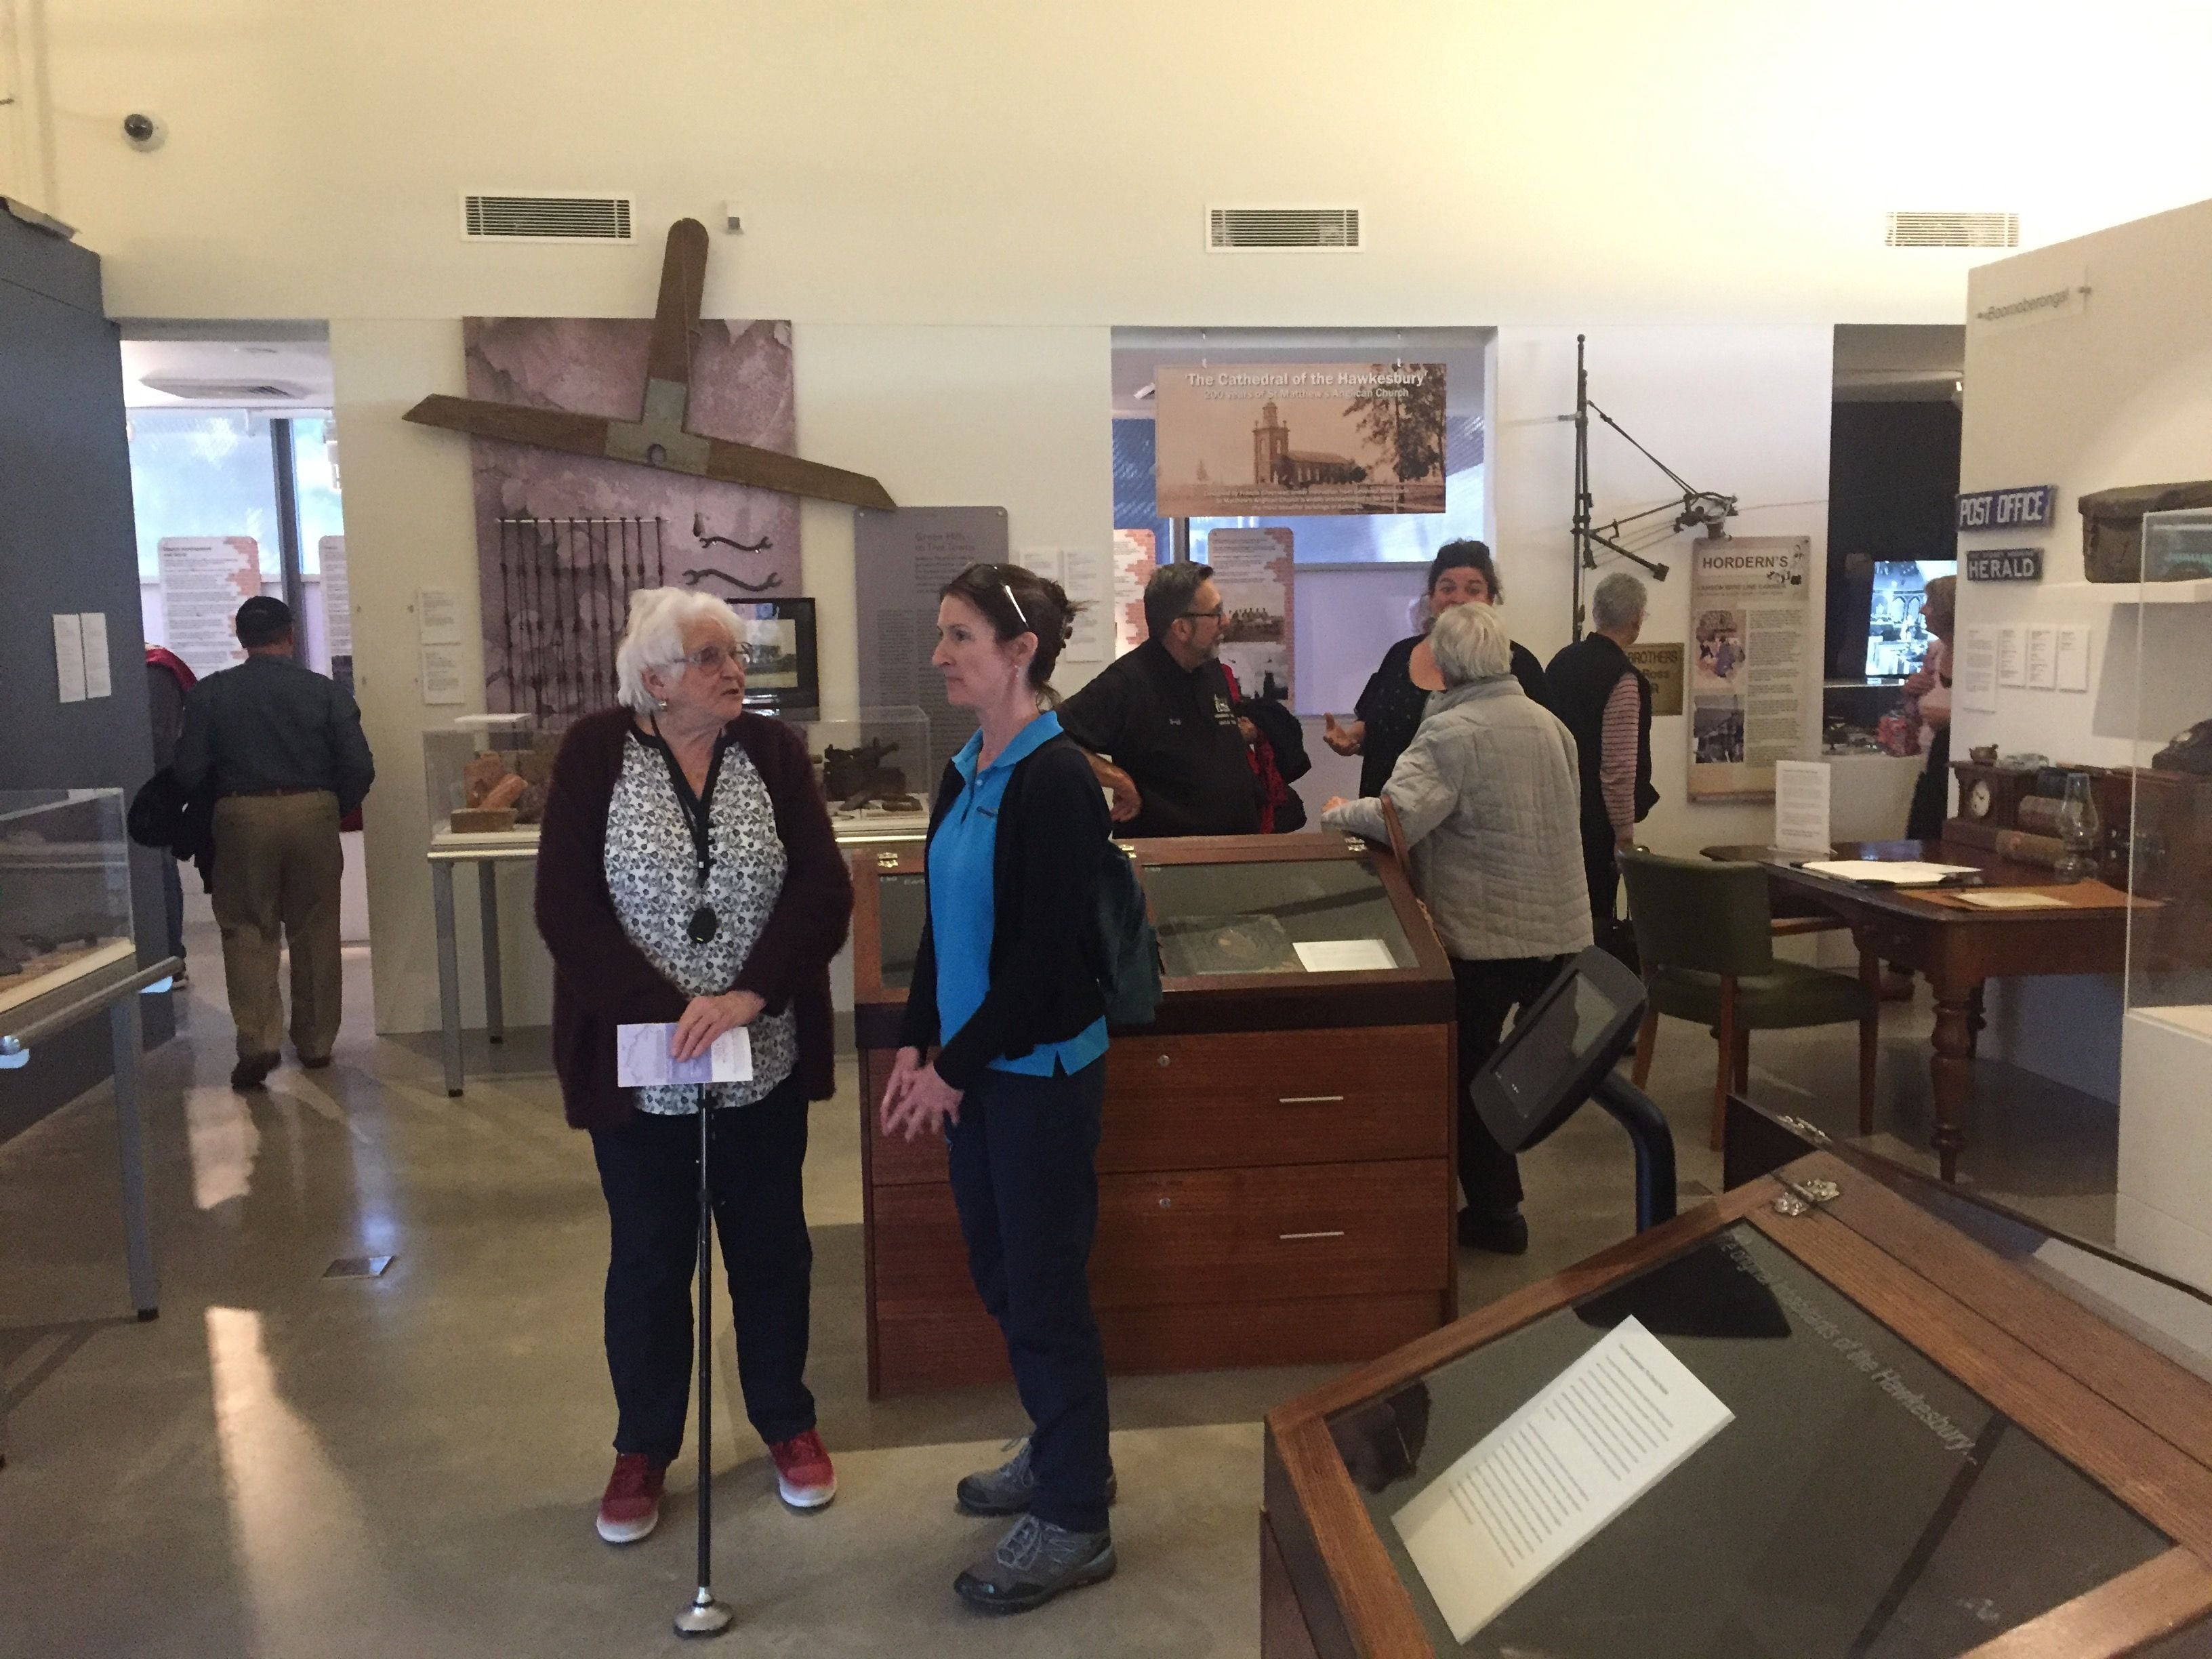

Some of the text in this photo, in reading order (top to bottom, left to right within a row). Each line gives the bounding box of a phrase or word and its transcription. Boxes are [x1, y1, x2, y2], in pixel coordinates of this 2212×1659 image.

[1219, 373, 1288, 386] Cathedral
[1293, 372, 1307, 386] of
[1311, 373, 1334, 385] the
[1204, 391, 1225, 400] 200
[1256, 390, 1267, 398] of
[1268, 390, 1278, 398] St
[1331, 388, 1373, 398] Anglican
[1376, 388, 1409, 398] Church
[1960, 491, 2044, 526] POST OFFICE
[1702, 556, 1788, 569] HORDERN'S
[1968, 558, 2034, 579] HERALD
[1628, 651, 1677, 663] BROTHERS
[1846, 1350, 1879, 1372] the
